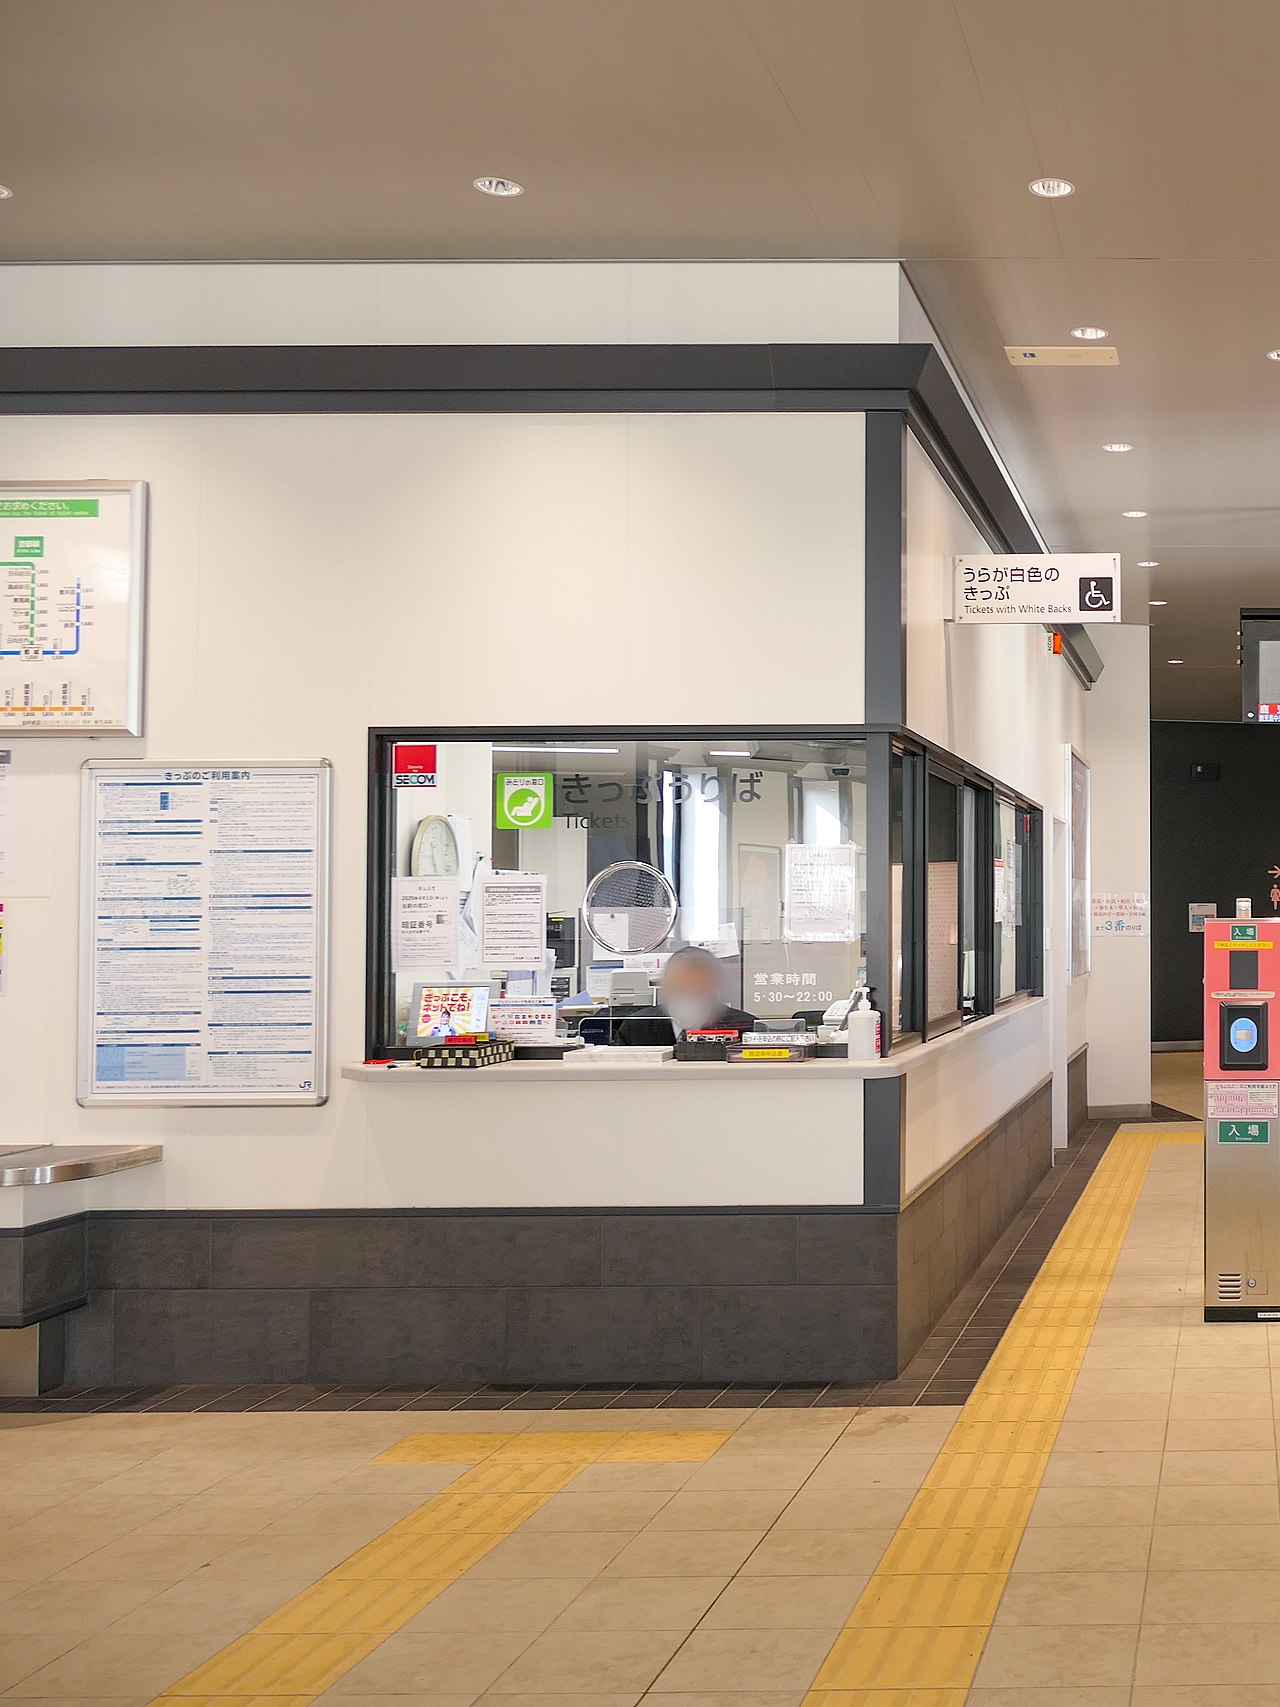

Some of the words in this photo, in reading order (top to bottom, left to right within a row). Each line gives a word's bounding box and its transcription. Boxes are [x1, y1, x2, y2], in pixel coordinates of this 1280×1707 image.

[963, 566, 1060, 583] うらが白色の
[963, 585, 1010, 601] きっぷ
[964, 604, 994, 614] Tickets
[995, 604, 1016, 613] with
[1018, 604, 1045, 613] White
[1048, 604, 1072, 613] Backs
[164, 771, 251, 781] きっぷのご利用案内
[396, 774, 434, 784] SECOM
[505, 778, 544, 786] みどりの窓口
[562, 770, 764, 804] きっぷうりば
[564, 813, 632, 830] Tickets
[401, 920, 434, 929] 暗証番号
[1095, 919, 1142, 932] 全て3番のりば
[1233, 928, 1255, 936] 入場
[753, 972, 817, 986] 営業時間
[424, 992, 472, 1003] きっぷこそ、
[422, 1002, 471, 1013] ネットでね!
[299, 1080, 312, 1088] JR
[1228, 1124, 1260, 1137] 入場
